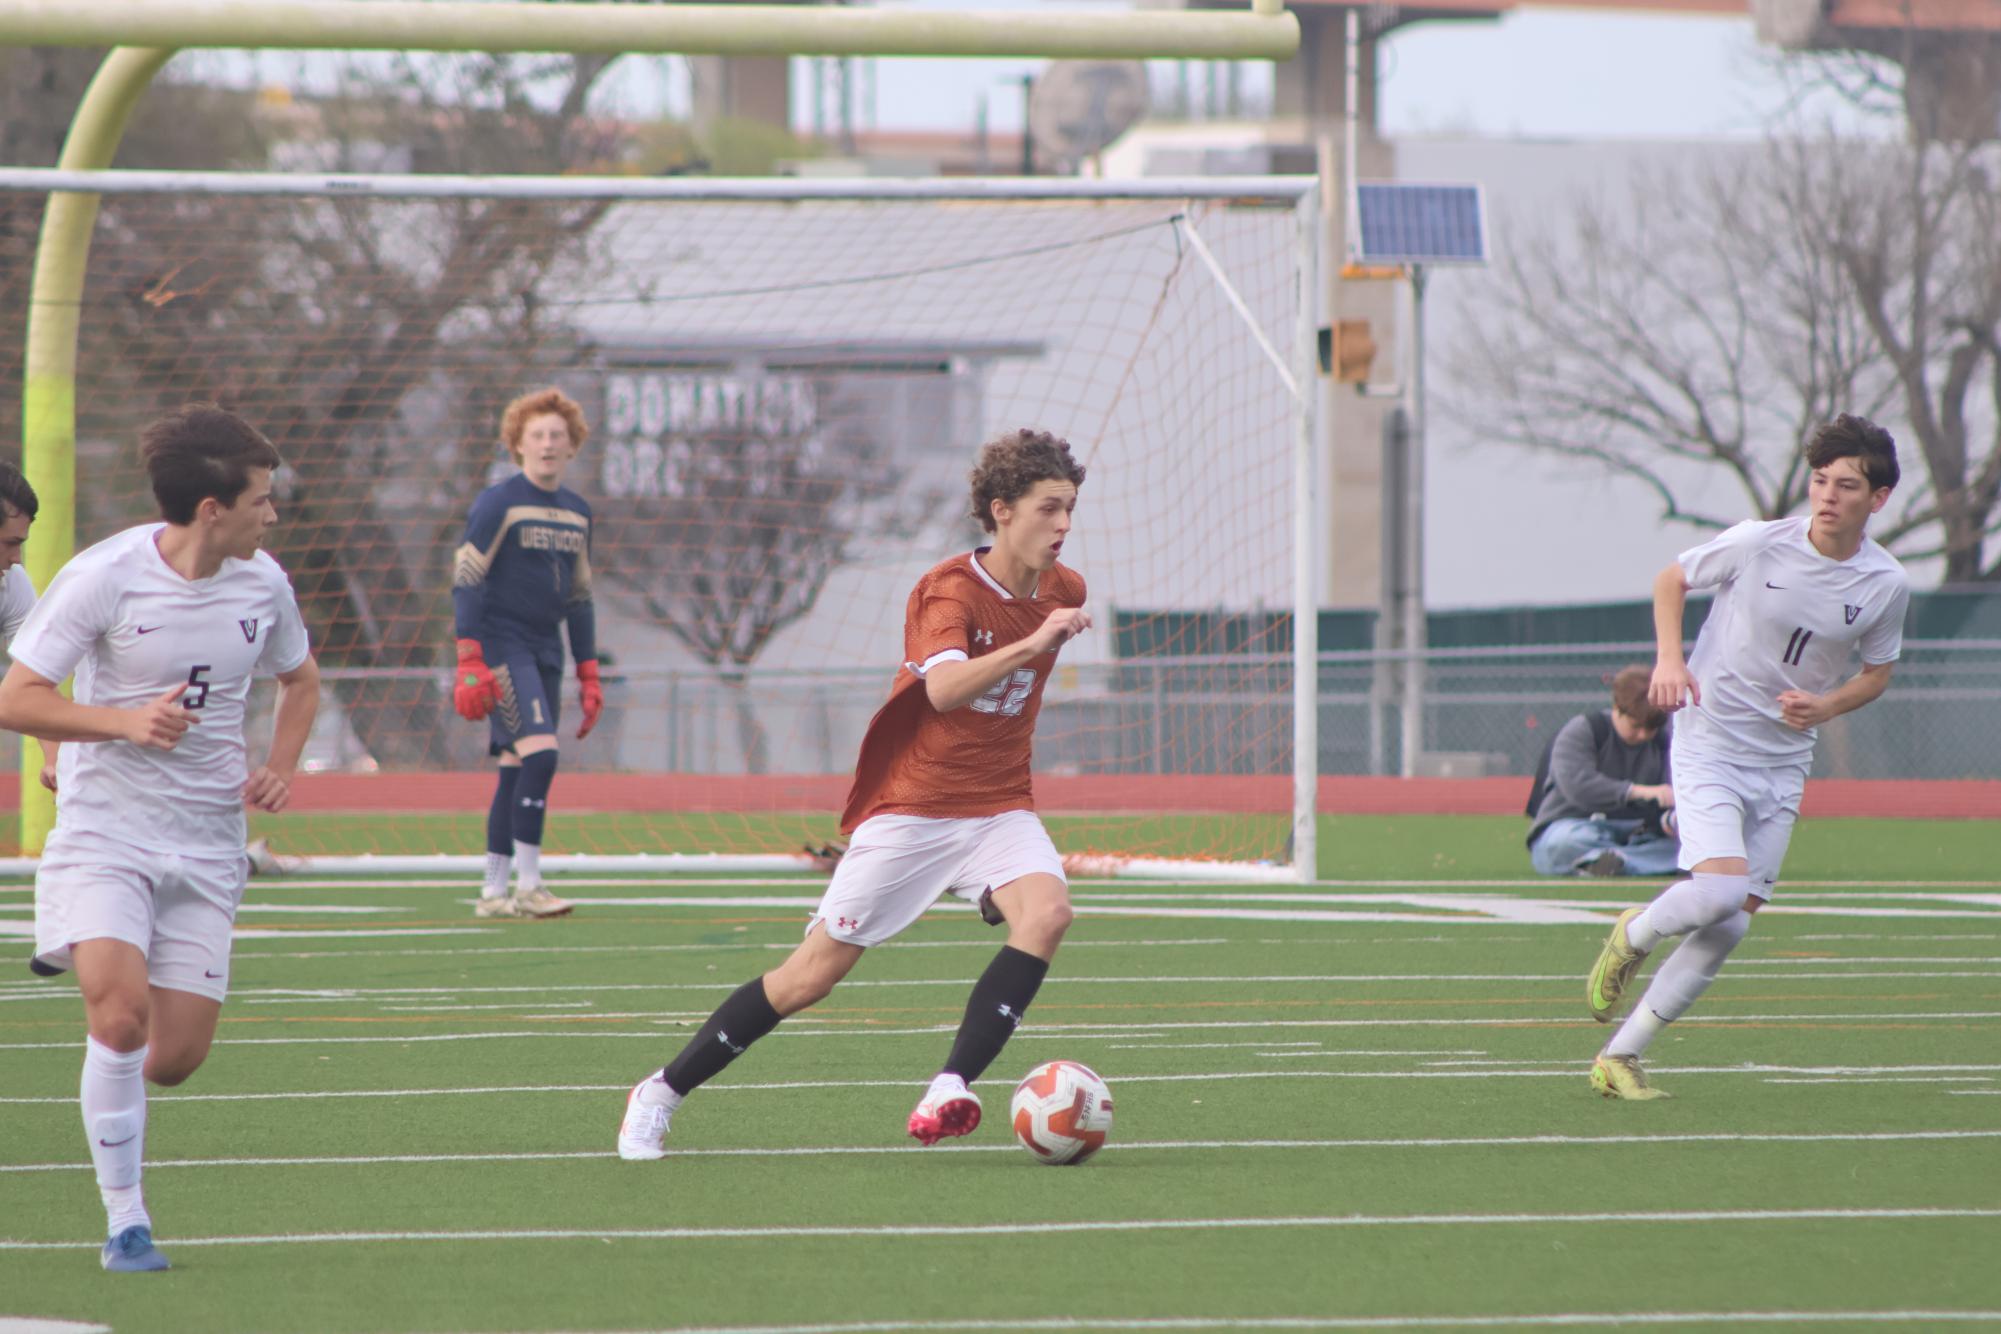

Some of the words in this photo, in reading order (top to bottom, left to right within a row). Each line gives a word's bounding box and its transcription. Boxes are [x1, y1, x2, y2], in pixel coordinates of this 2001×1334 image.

[1783, 627, 1813, 666] 11
[183, 665, 210, 709] 5
[970, 668, 1037, 716] 22
[532, 698, 544, 724] 1
